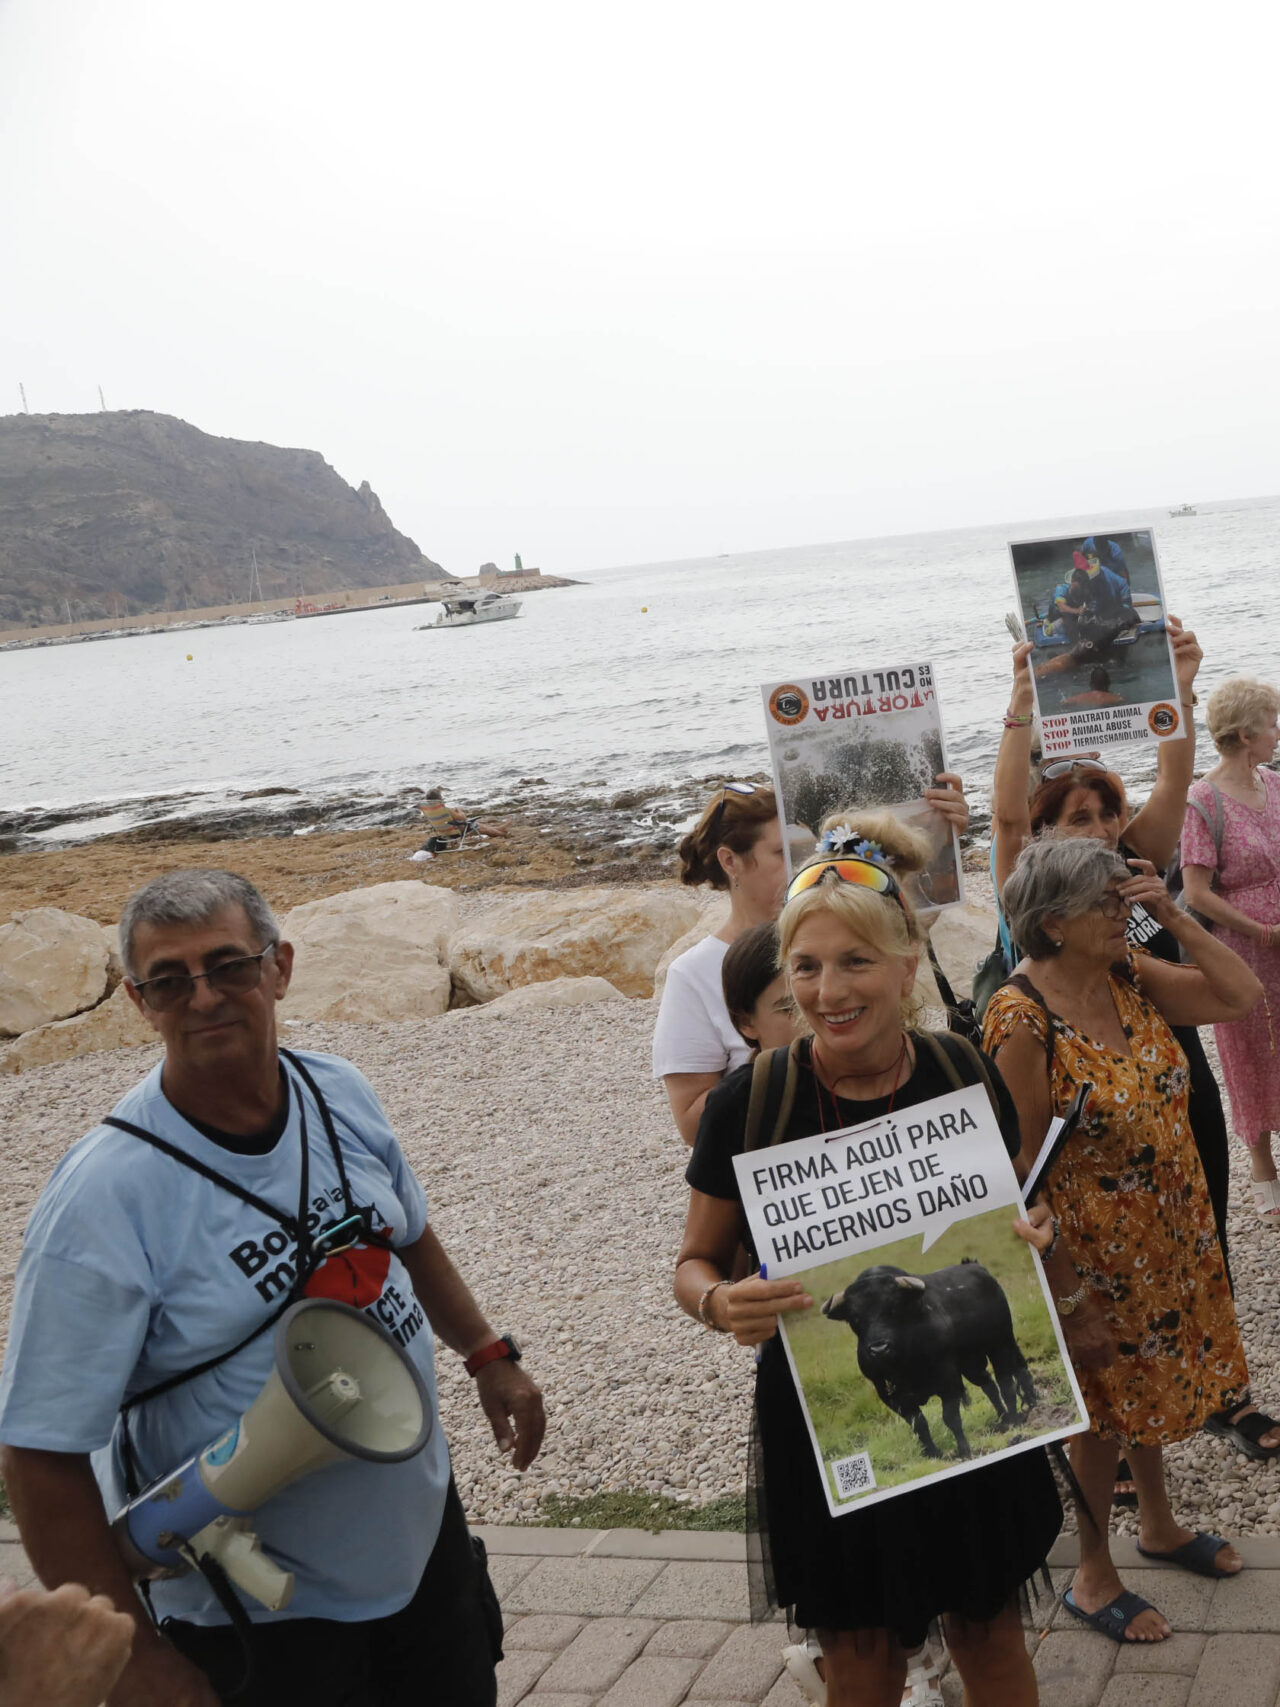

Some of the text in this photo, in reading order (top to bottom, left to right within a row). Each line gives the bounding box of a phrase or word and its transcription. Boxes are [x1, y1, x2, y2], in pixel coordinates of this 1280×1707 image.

[812, 669, 915, 701] CULTURA
[919, 666, 929, 675] ES
[920, 677, 932, 687] NO
[813, 692, 924, 721] TORTURA
[1042, 707, 1143, 729] STOP MALTRATO ANIMAL
[1044, 720, 1132, 740] STOP ANIMAL ABUSE
[1046, 729, 1148, 752] STOP TIERMISSHANDLUNG
[1124, 916, 1163, 945] TURA
[753, 1107, 978, 1195] FIRMA AQUÍ PARA
[762, 1153, 945, 1227] QUE DEJEN DE
[771, 1172, 989, 1263] HACERNOS DAÑO
